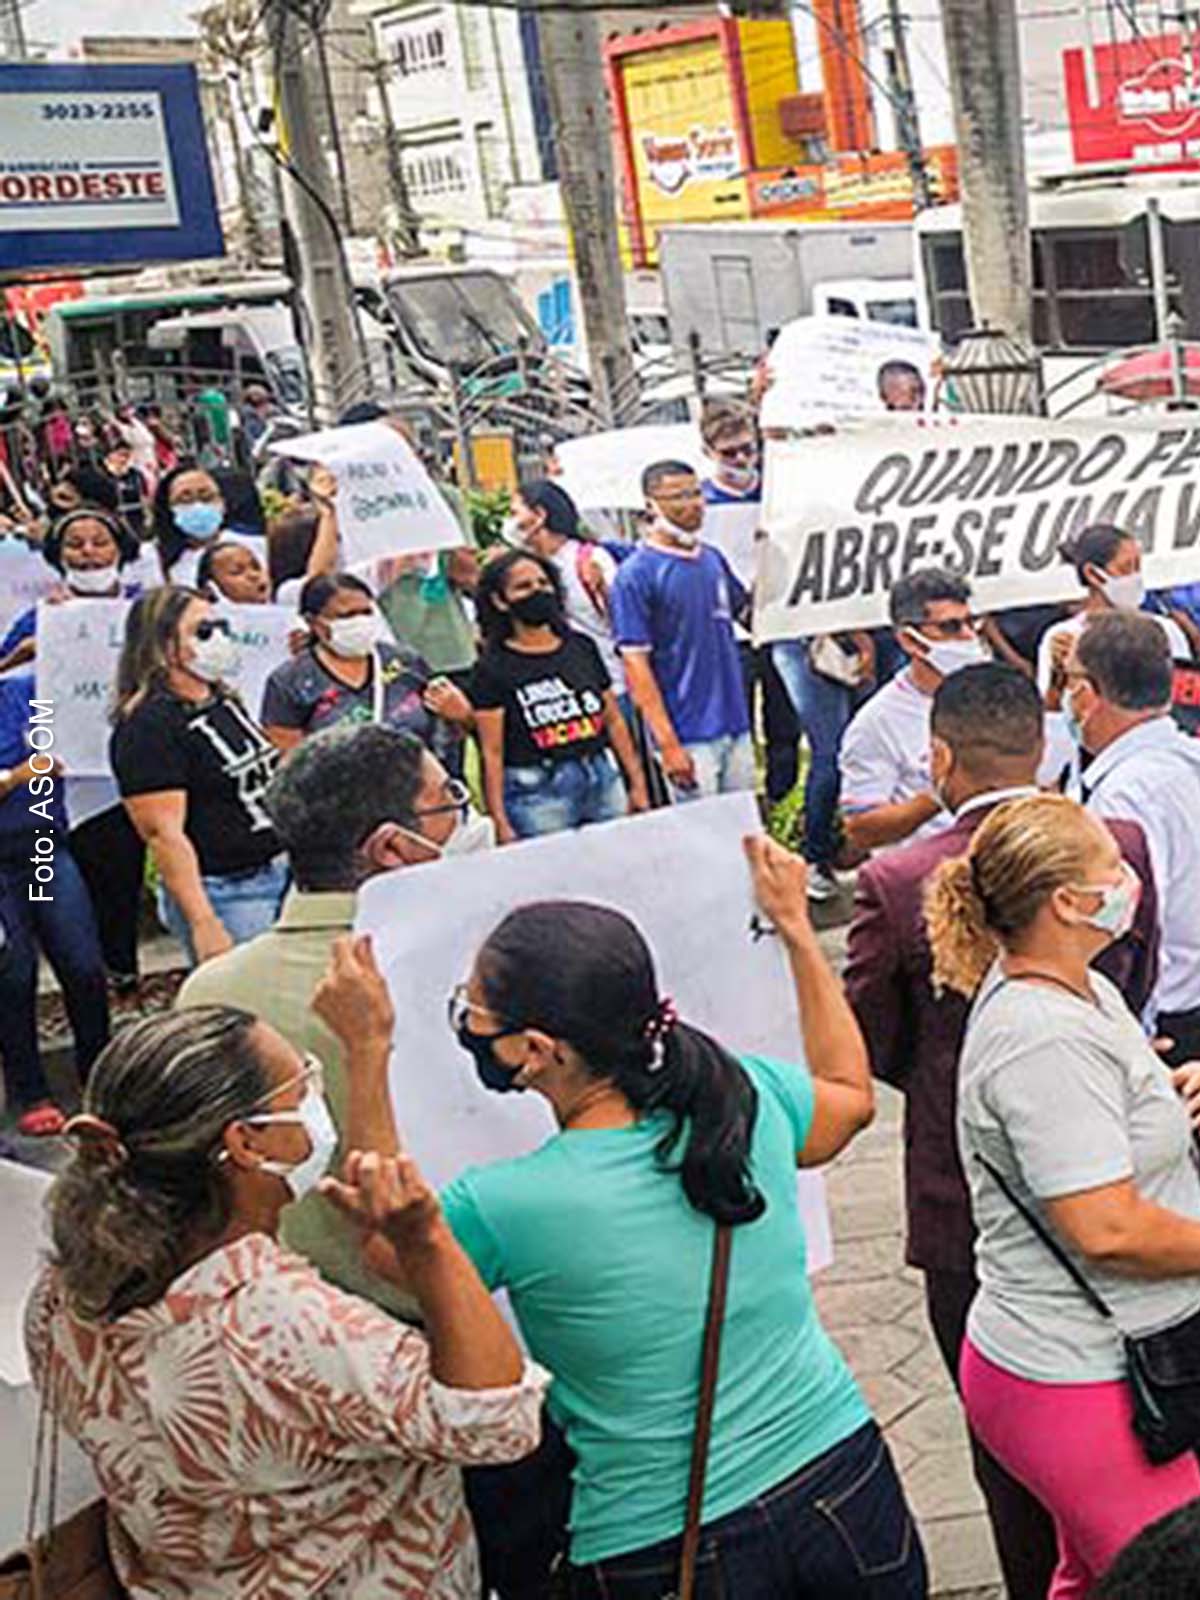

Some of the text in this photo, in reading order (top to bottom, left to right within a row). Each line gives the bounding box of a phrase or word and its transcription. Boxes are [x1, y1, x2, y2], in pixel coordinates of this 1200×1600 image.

[42, 103, 154, 119] 3023-2255
[854, 435, 1127, 516] QUANDO
[788, 504, 1017, 607] ABRE-SE
